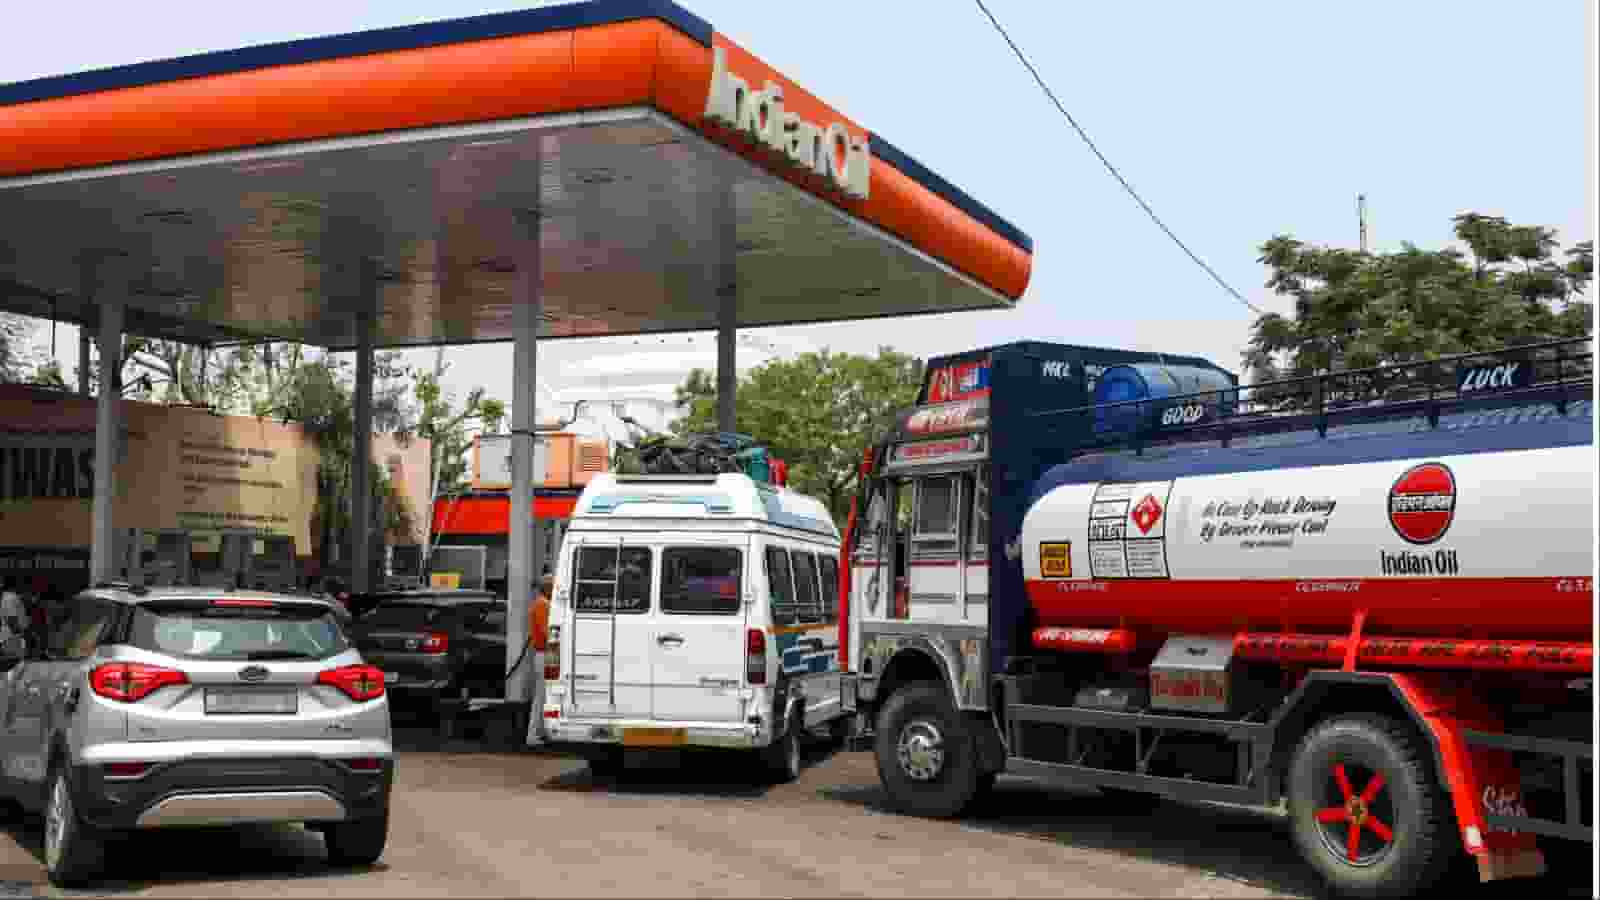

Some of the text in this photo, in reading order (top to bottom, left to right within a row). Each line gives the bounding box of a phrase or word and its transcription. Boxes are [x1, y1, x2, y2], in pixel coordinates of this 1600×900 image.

[1461, 362, 1520, 391] LUCK
[1162, 405, 1204, 426] GOOD
[1380, 550, 1459, 576] Indian Oil
